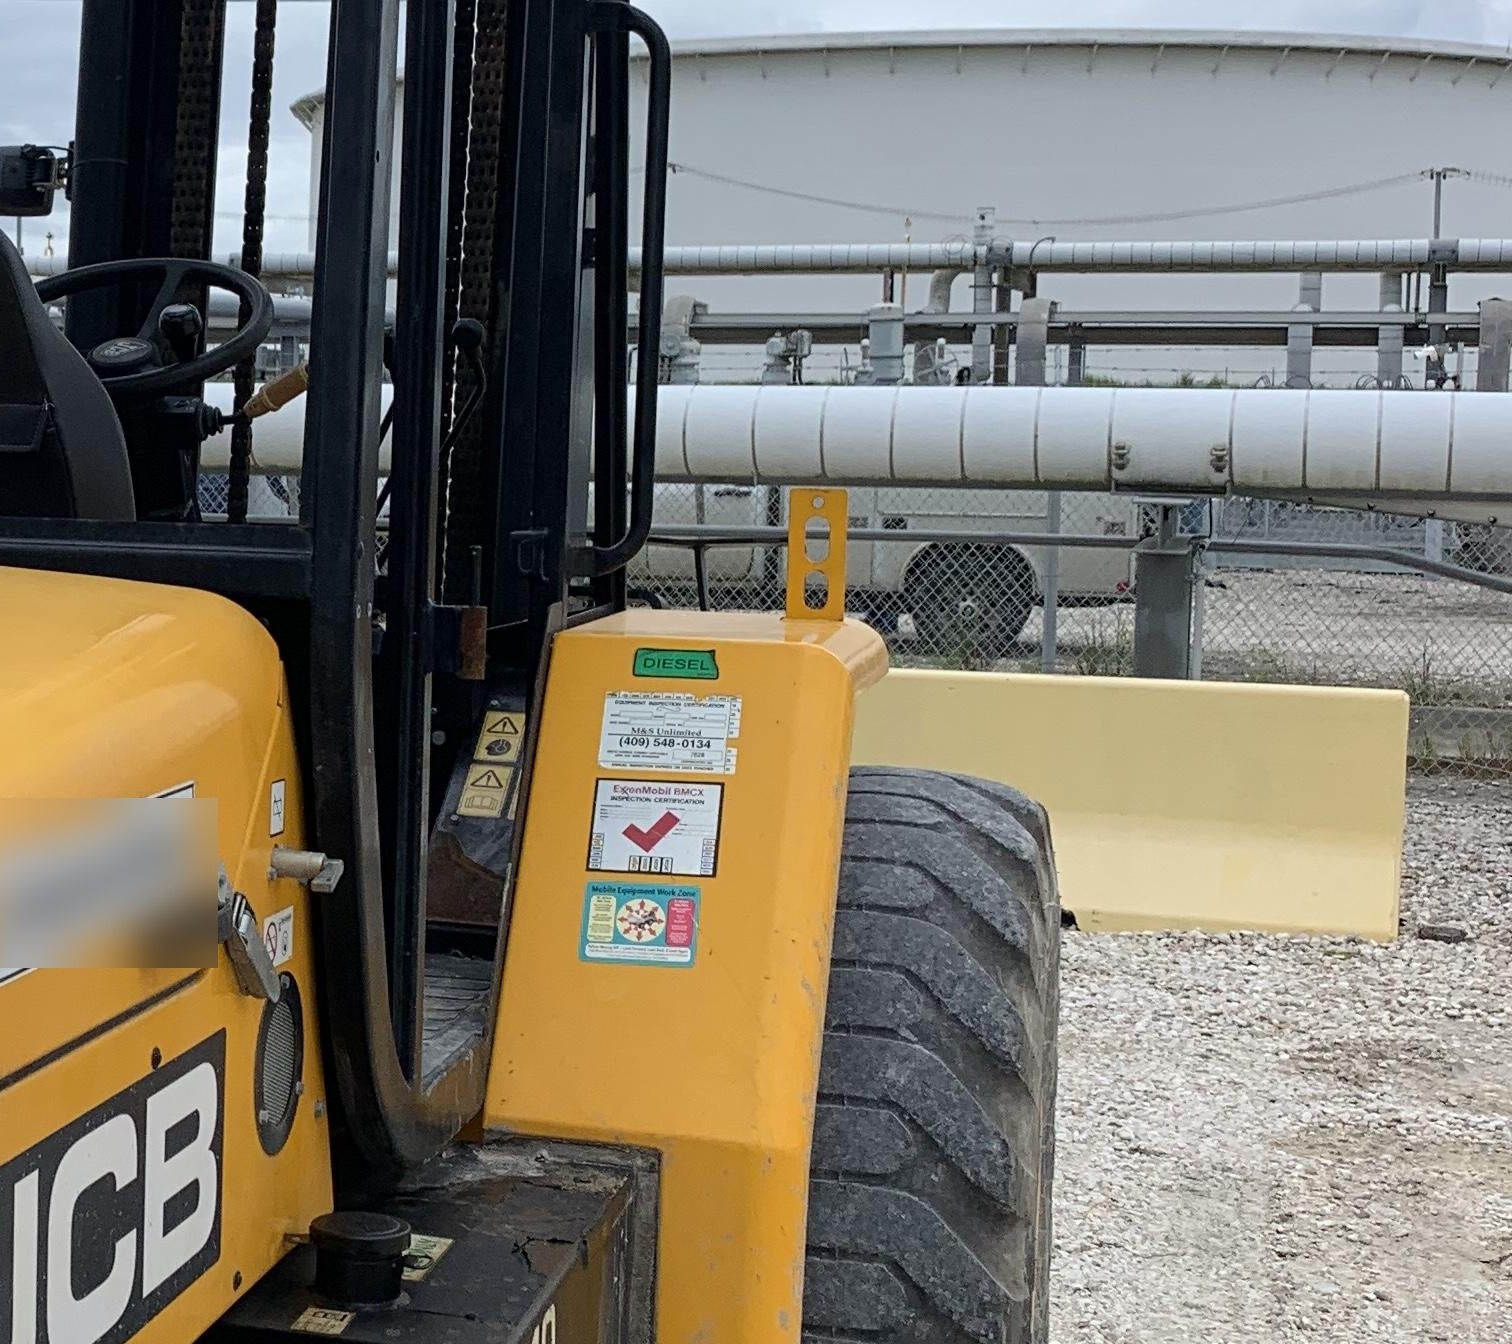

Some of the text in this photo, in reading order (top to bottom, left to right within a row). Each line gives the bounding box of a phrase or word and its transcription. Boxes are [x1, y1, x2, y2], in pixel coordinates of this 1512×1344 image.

[643, 658, 710, 671] DIESEL
[631, 727, 702, 736] M&S Unlimited
[619, 736, 711, 749] (409) 548-0134
[613, 784, 704, 797] ExxonMobil BMCX
[653, 797, 705, 805] CERTIFICATION
[618, 887, 656, 896] Equipment
[657, 888, 677, 896] Work
